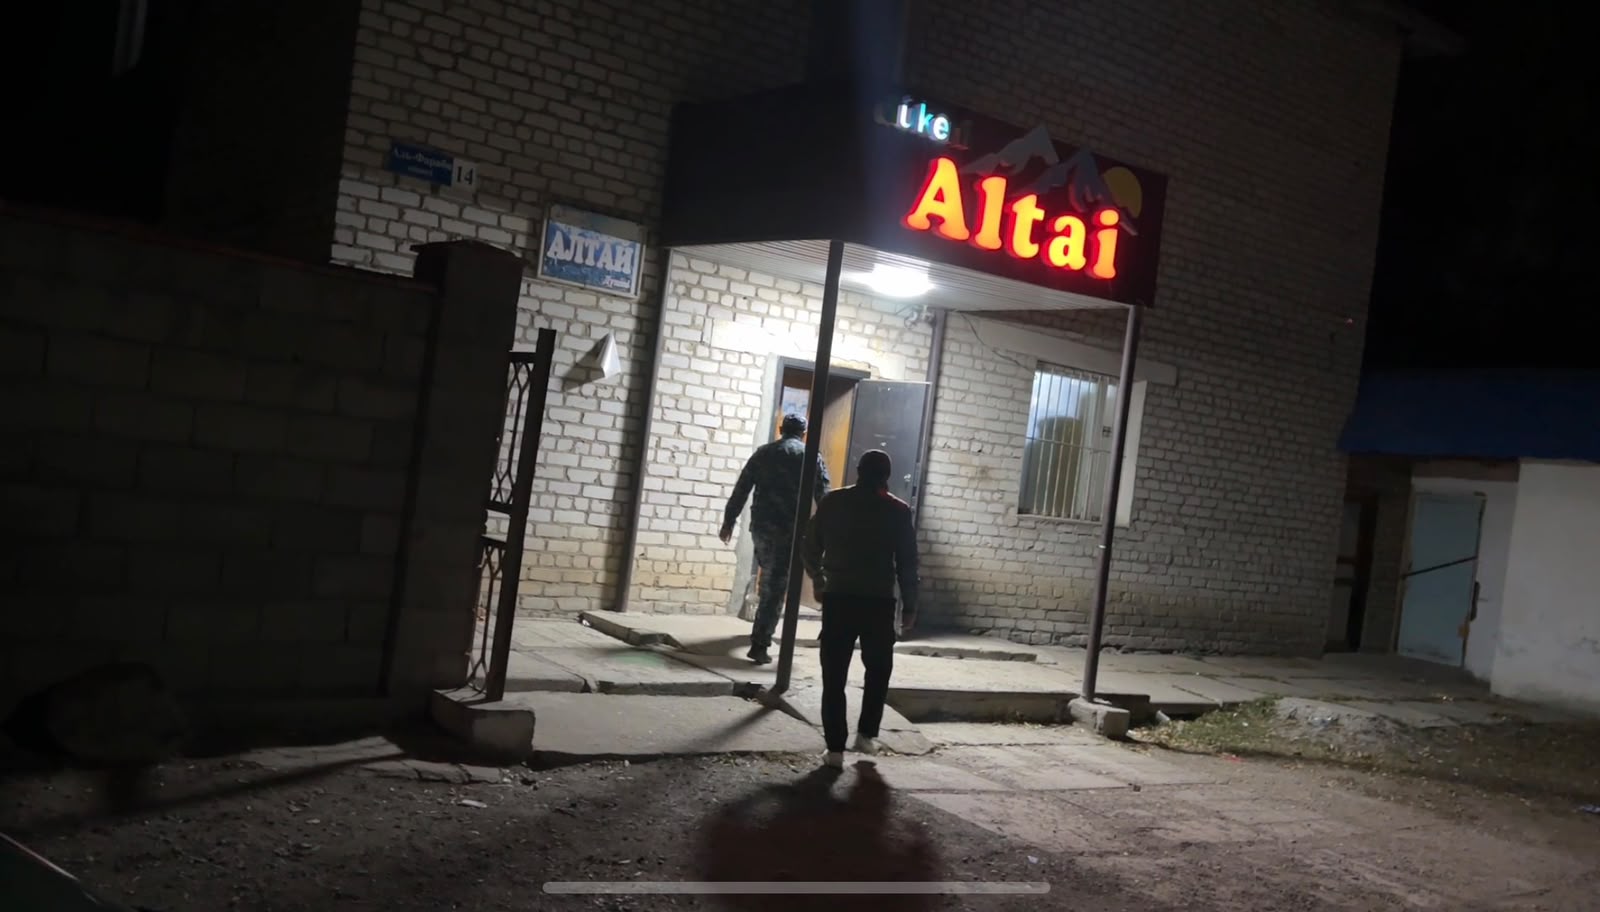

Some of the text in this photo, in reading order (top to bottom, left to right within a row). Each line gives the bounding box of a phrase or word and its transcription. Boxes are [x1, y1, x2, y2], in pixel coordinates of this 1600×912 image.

[457, 166, 474, 185] 14
[904, 157, 1119, 279] Altai
[547, 230, 633, 274] АЛТАЙ
